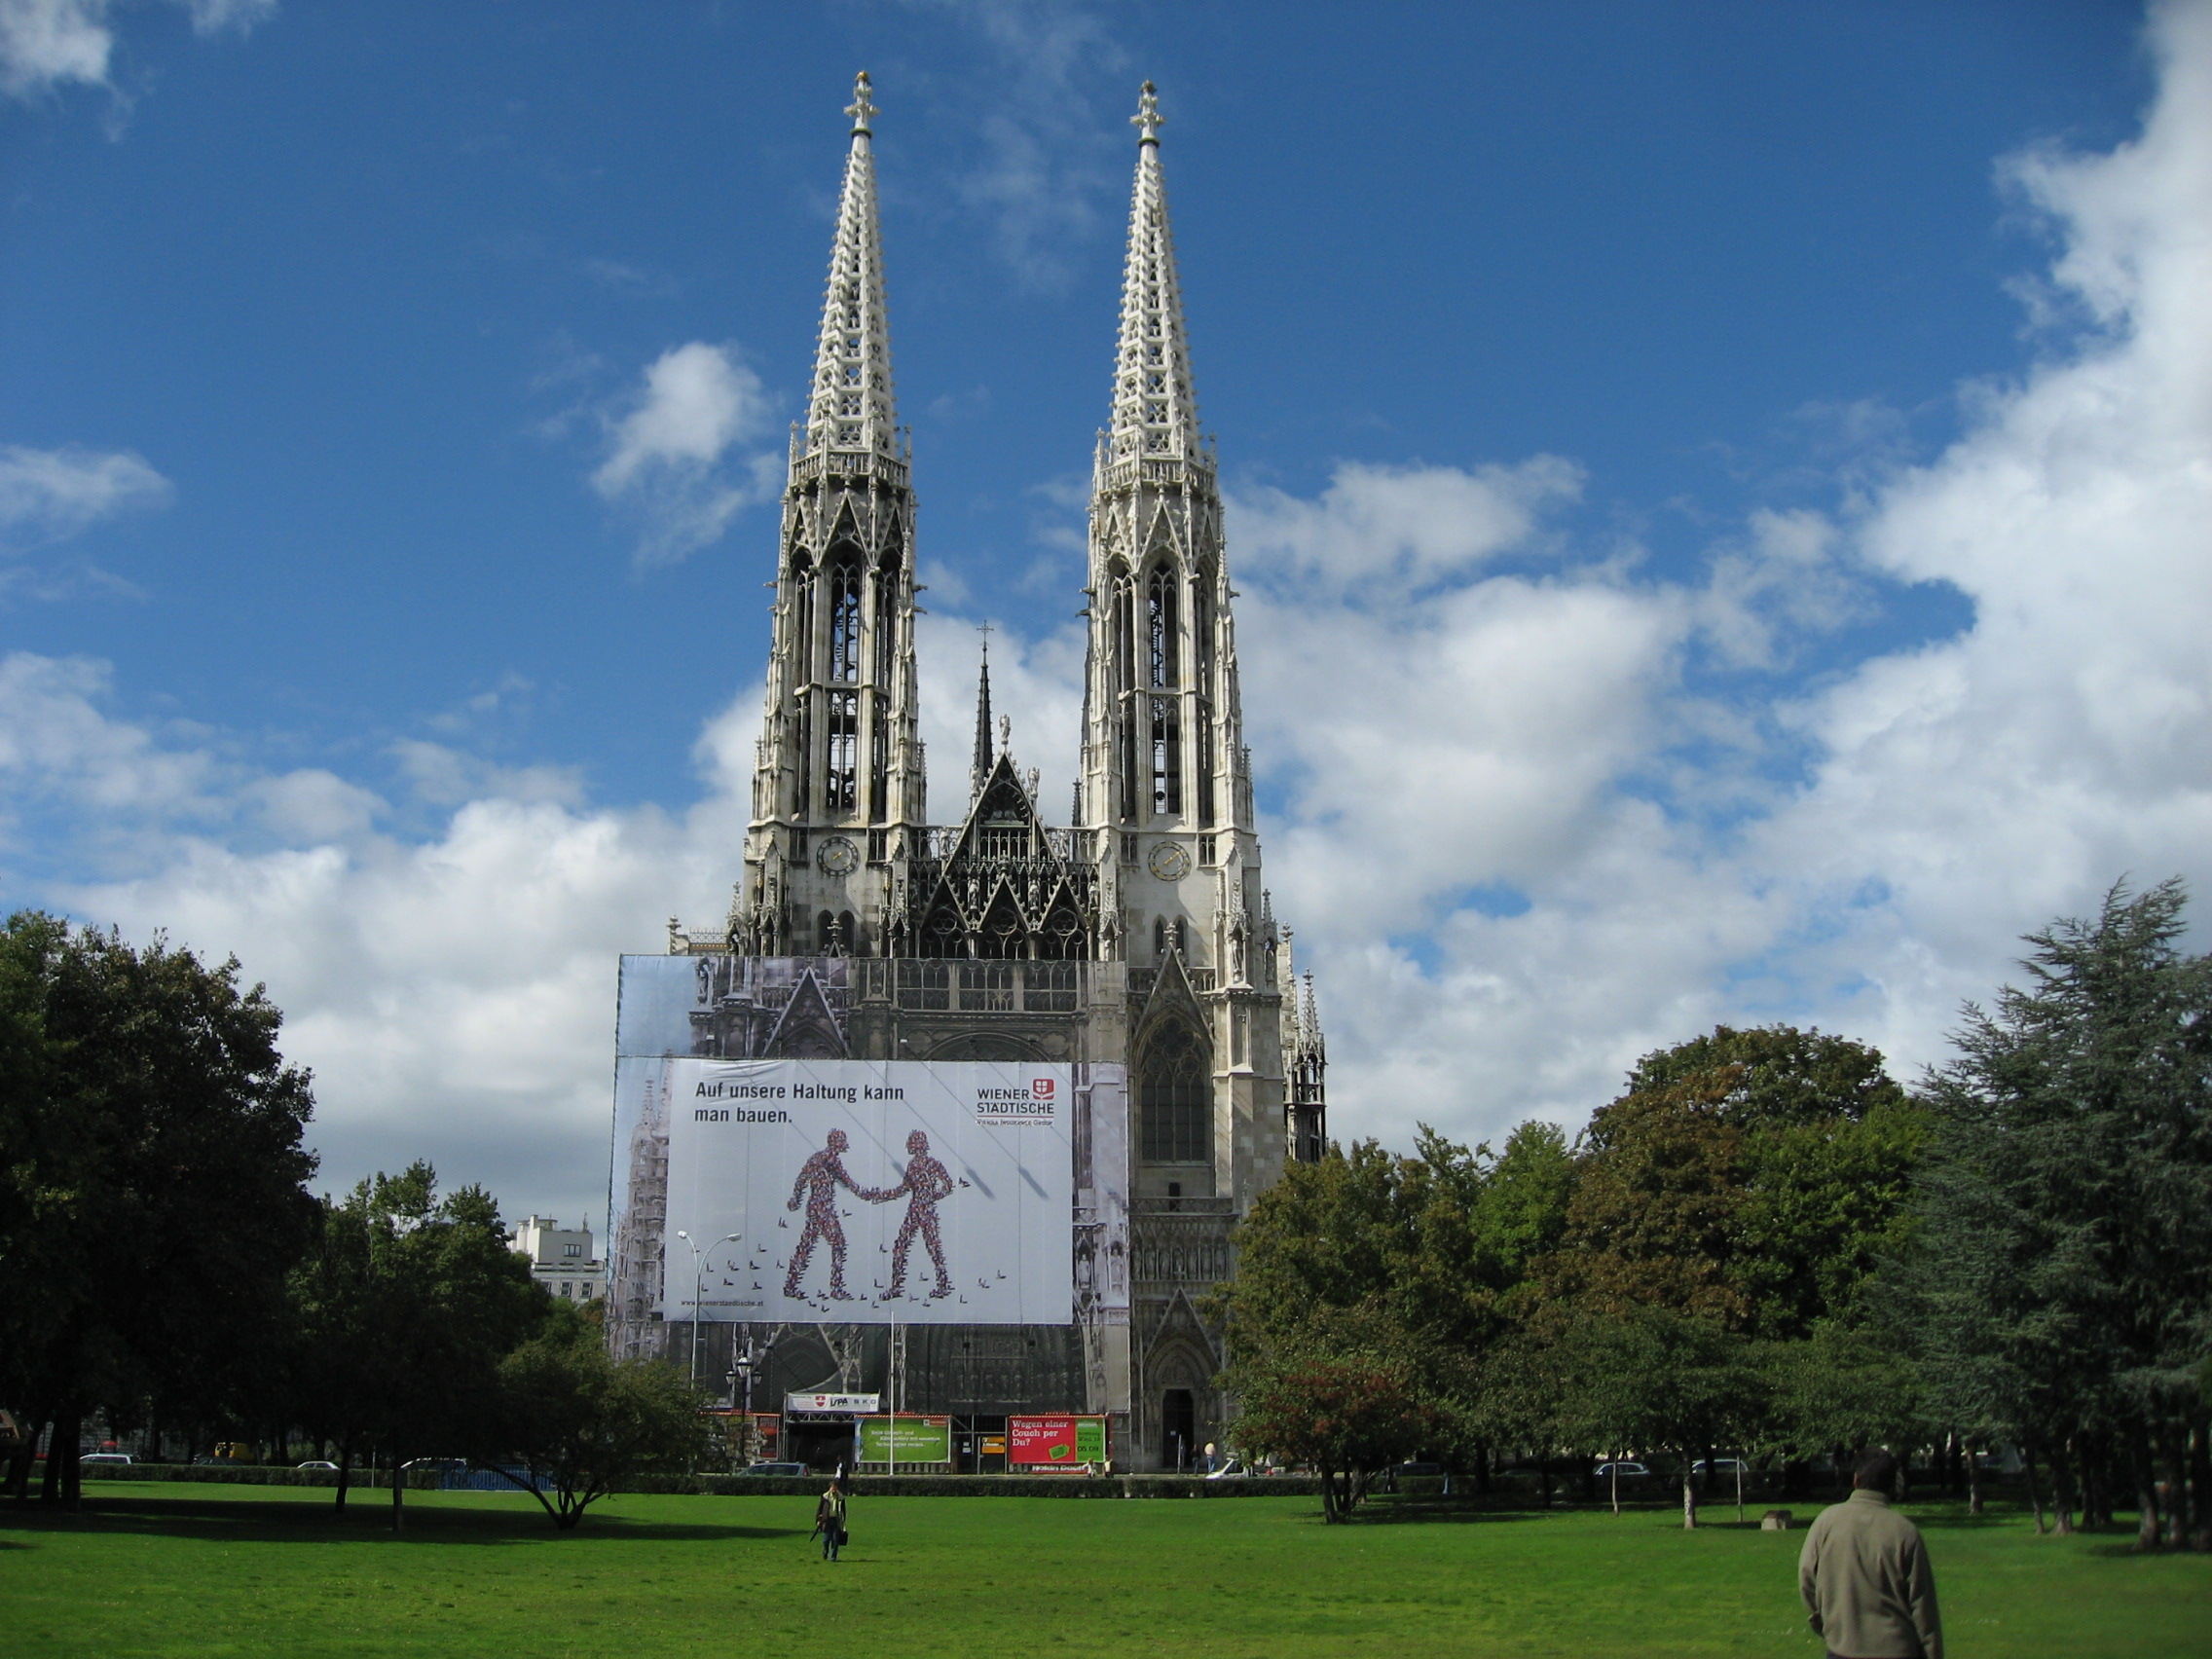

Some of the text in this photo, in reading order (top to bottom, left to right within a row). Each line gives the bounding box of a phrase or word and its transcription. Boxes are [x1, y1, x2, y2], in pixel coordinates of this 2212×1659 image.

[695, 1082, 904, 1103] Auf unsere Haltung kann
[977, 1088, 1030, 1100] WIENER
[977, 1101, 1055, 1115] STÄDTISCHE
[694, 1107, 793, 1124] man bauen.
[1012, 1419, 1043, 1429] Wegen
[1045, 1419, 1069, 1428] einer
[1012, 1428, 1058, 1438] Couch per
